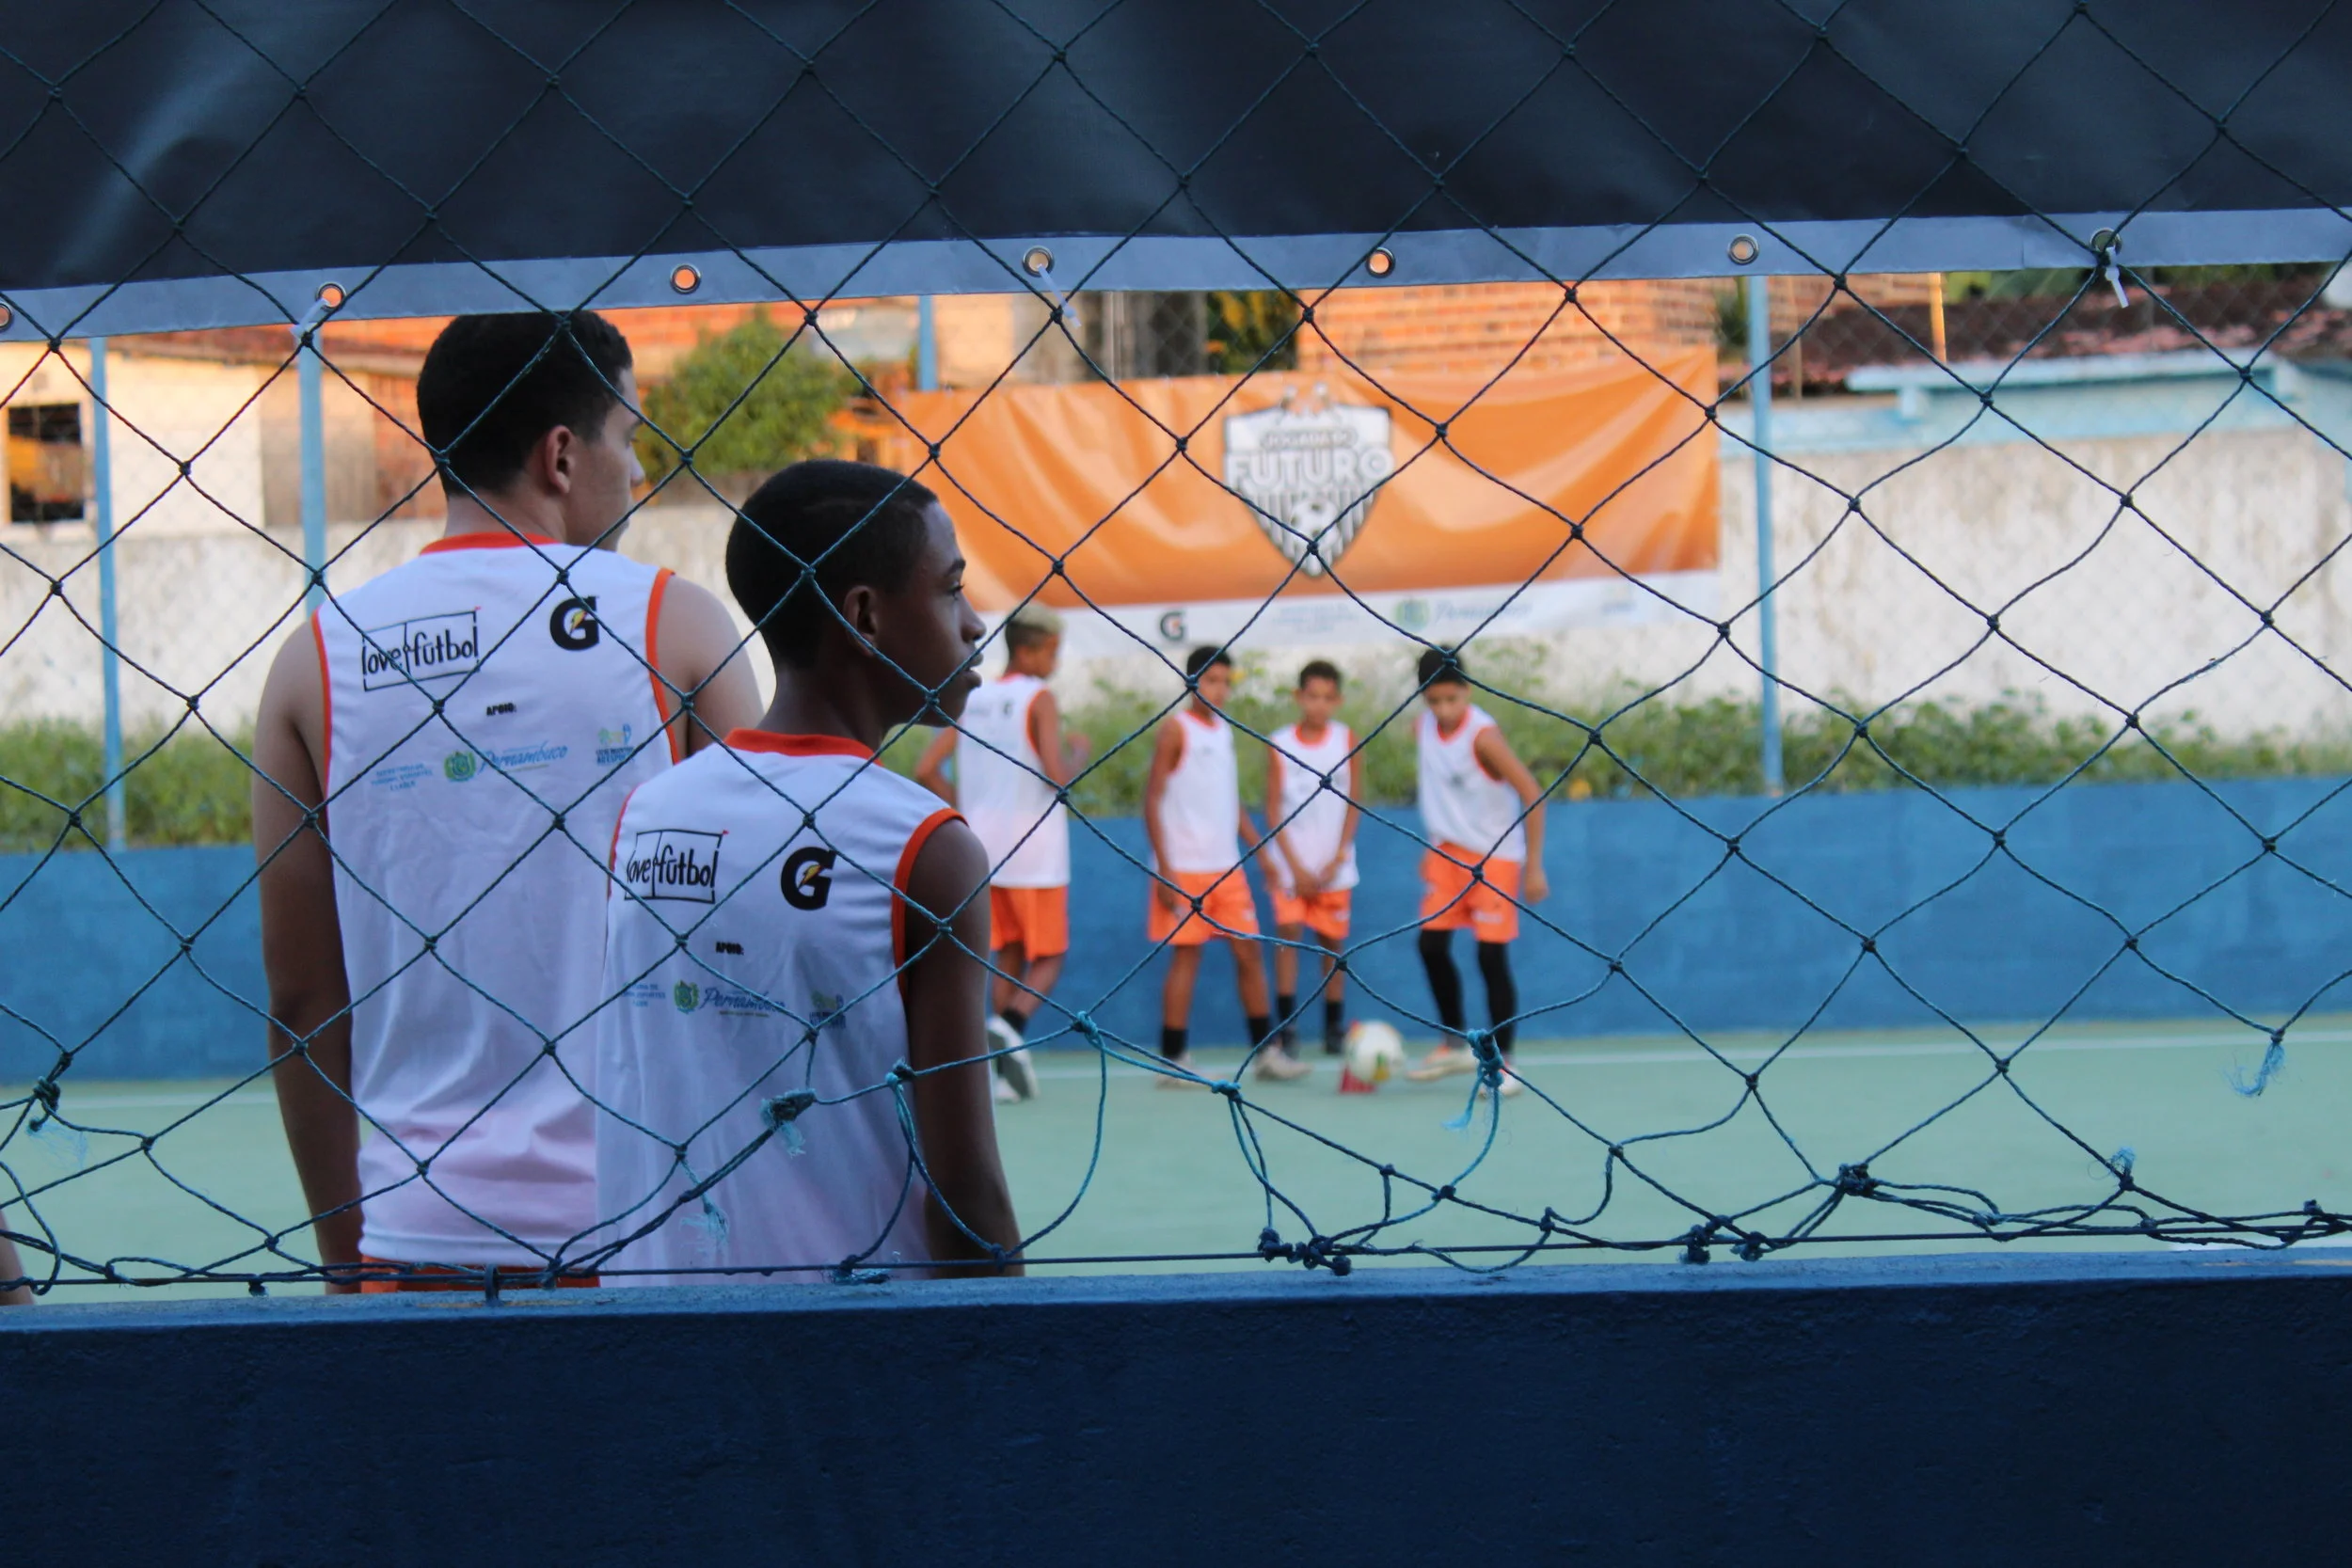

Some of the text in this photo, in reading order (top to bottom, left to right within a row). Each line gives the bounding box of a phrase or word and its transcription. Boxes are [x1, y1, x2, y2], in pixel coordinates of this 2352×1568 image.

[1226, 447, 1394, 488] FUTURO
[550, 596, 599, 650] G
[781, 847, 836, 911] G
